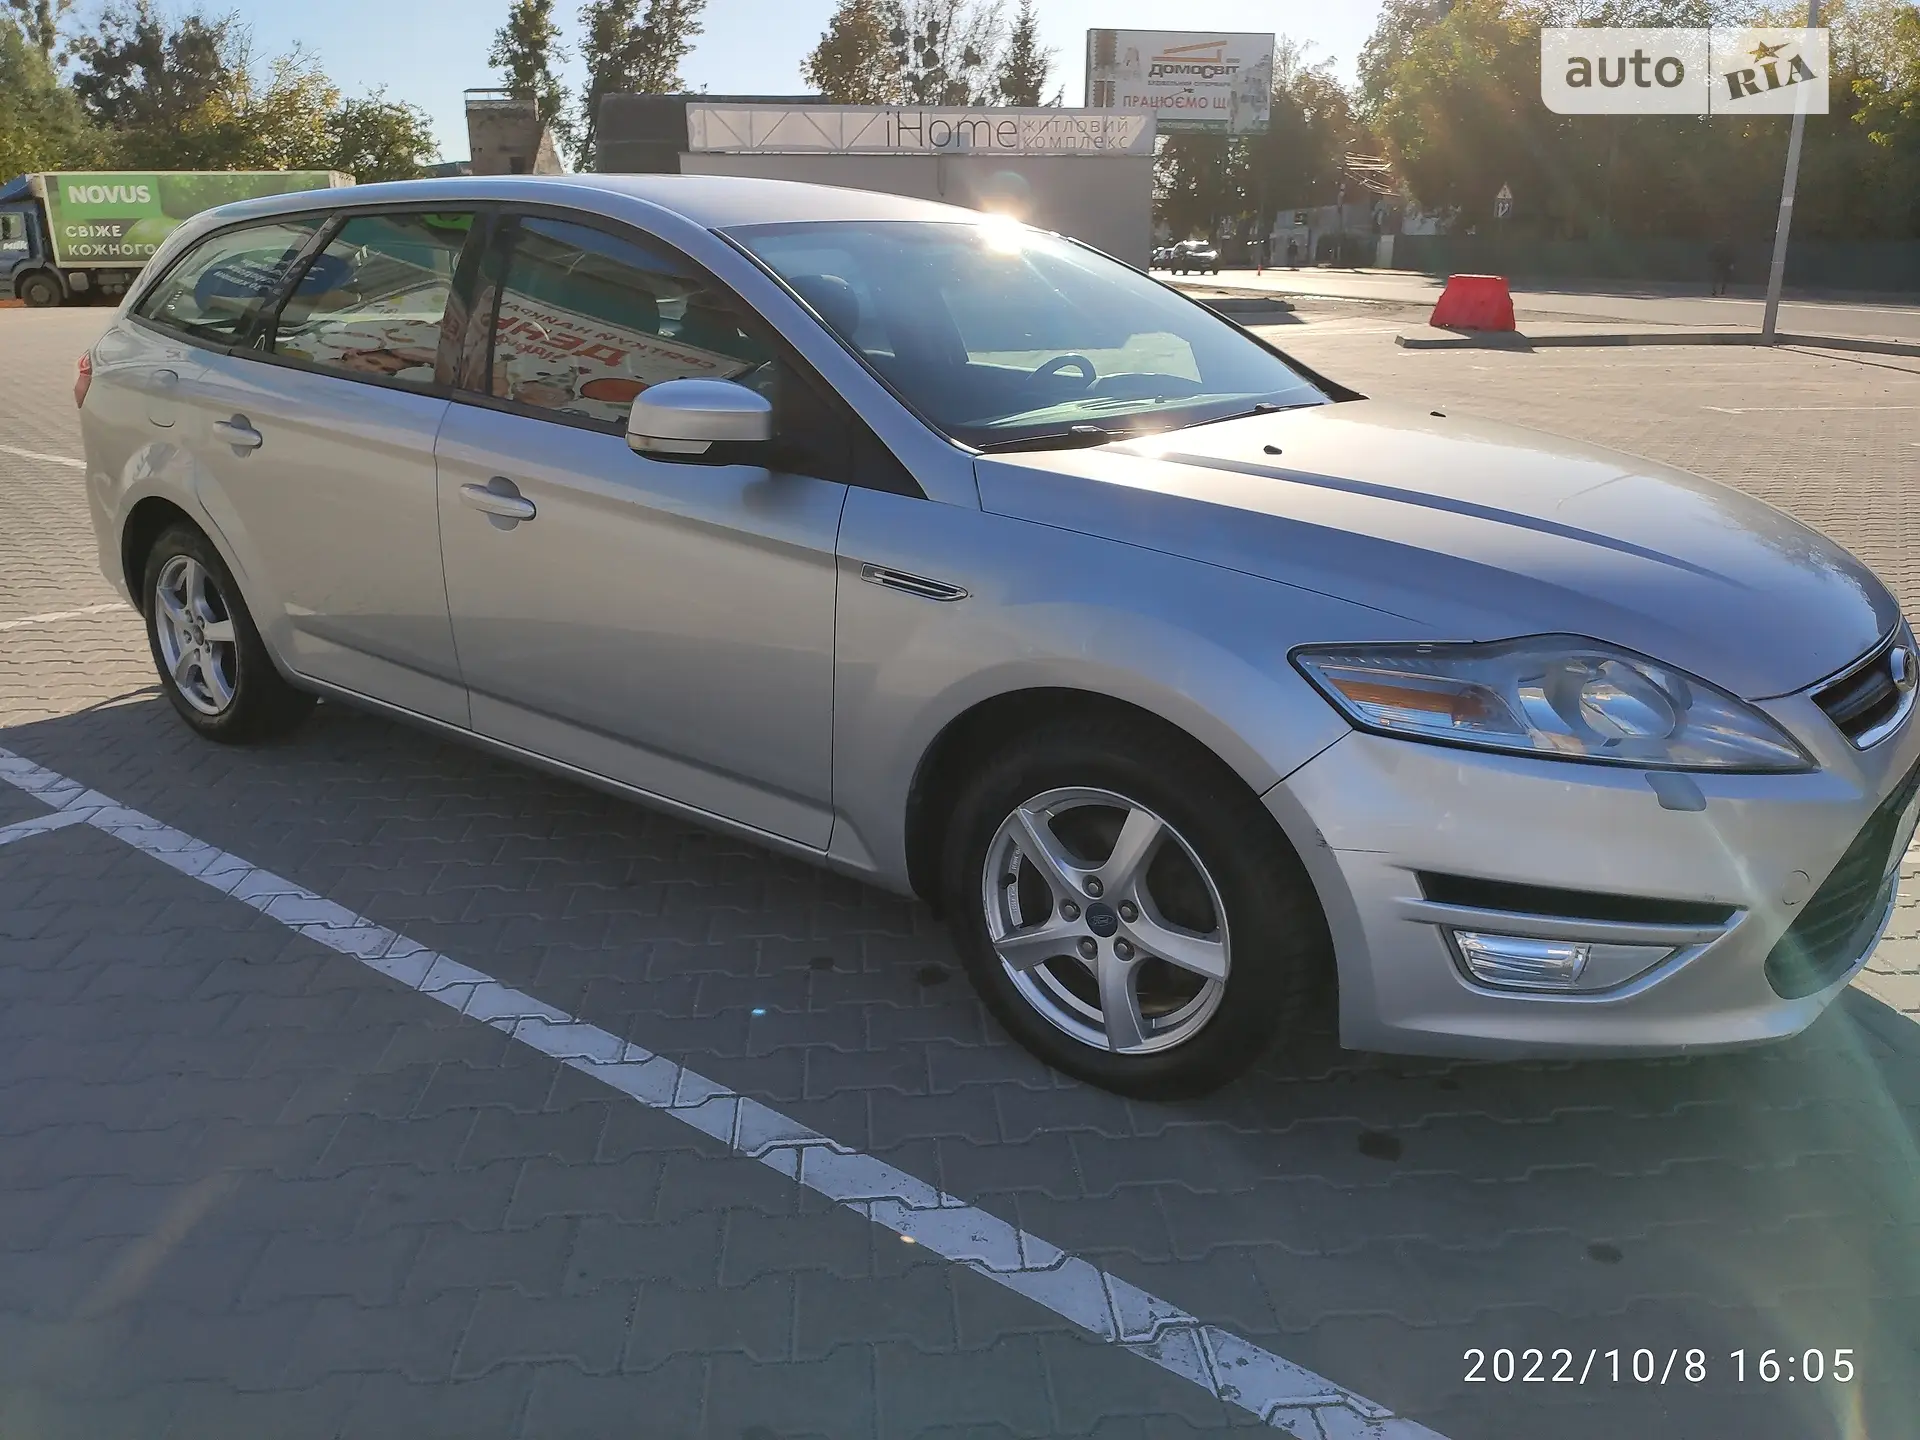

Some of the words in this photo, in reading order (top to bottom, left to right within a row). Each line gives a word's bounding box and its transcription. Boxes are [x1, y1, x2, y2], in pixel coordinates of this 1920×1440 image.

[1123, 95, 1208, 109] ПРАЦЮЄМО
[885, 111, 1018, 148] iHome
[68, 185, 151, 204] NOVUS
[65, 225, 122, 238] СВІЖЕ
[68, 244, 156, 256] КОЖНОГО
